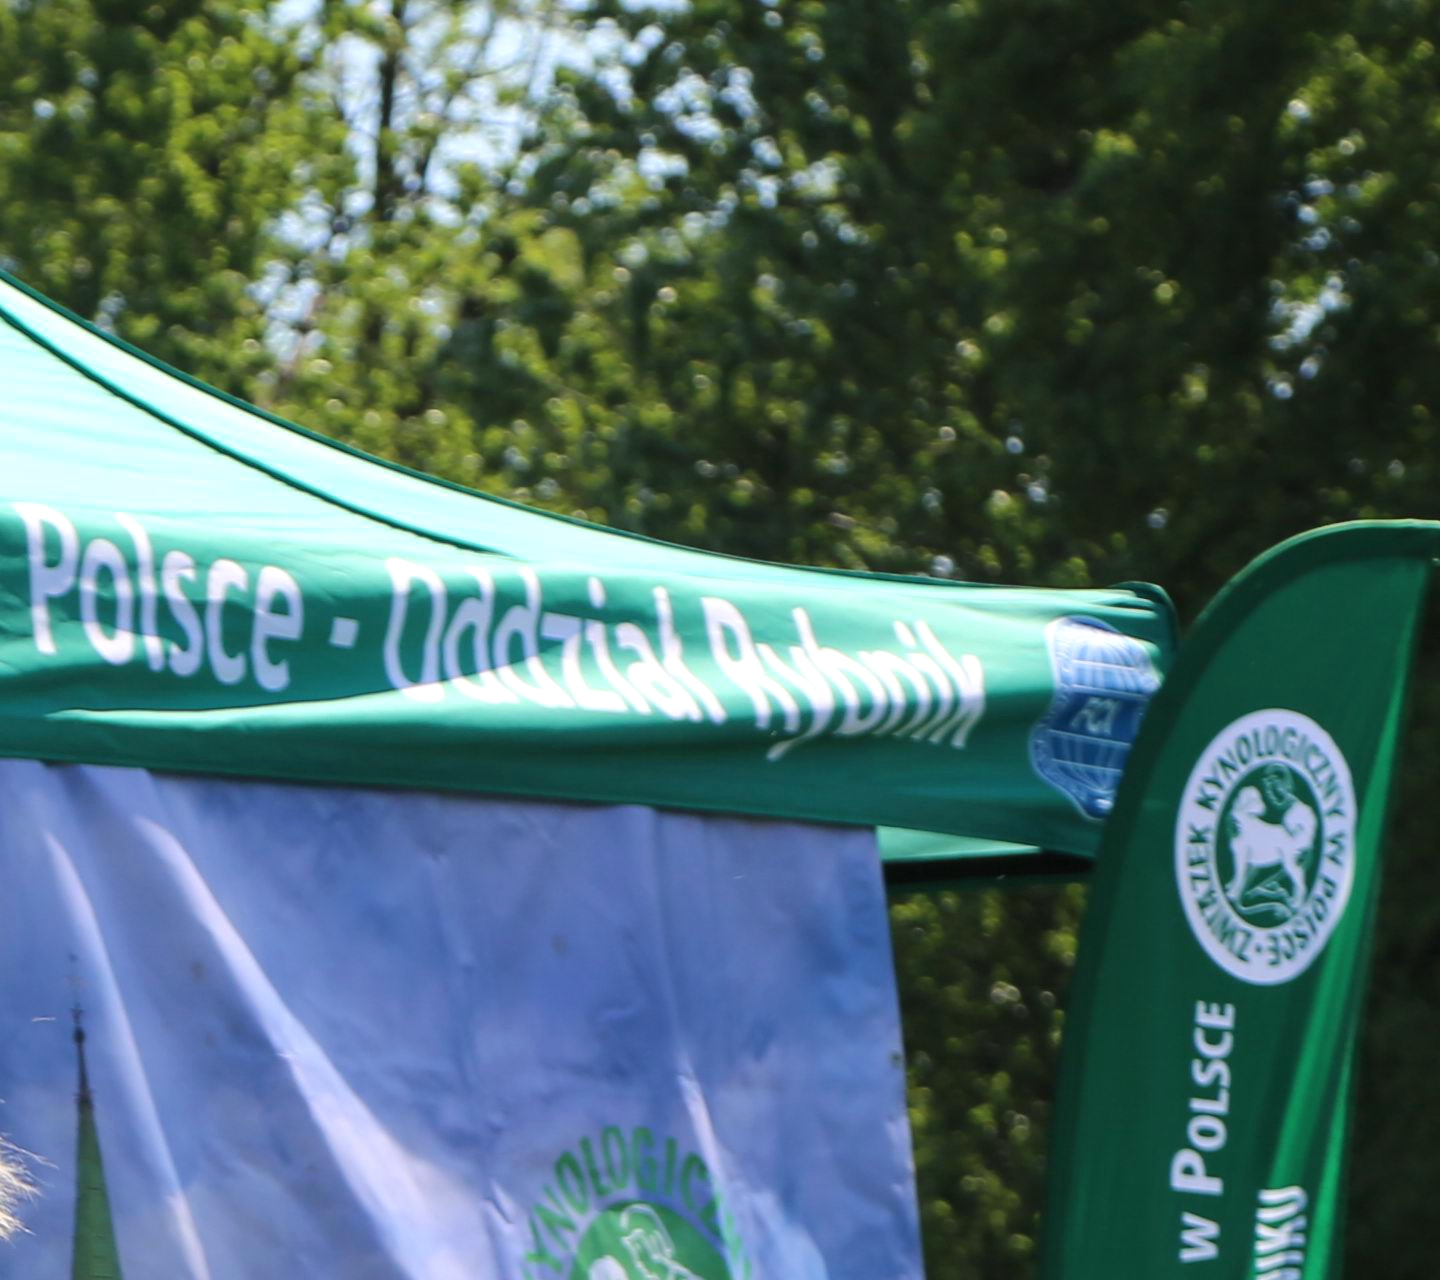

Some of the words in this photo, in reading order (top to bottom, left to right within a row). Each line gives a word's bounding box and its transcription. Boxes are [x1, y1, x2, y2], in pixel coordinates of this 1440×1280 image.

[14, 502, 303, 691] Polsce
[384, 557, 726, 725] Oddział
[700, 596, 986, 762] Rybnik
[1171, 1001, 1235, 1196] POLSCE
